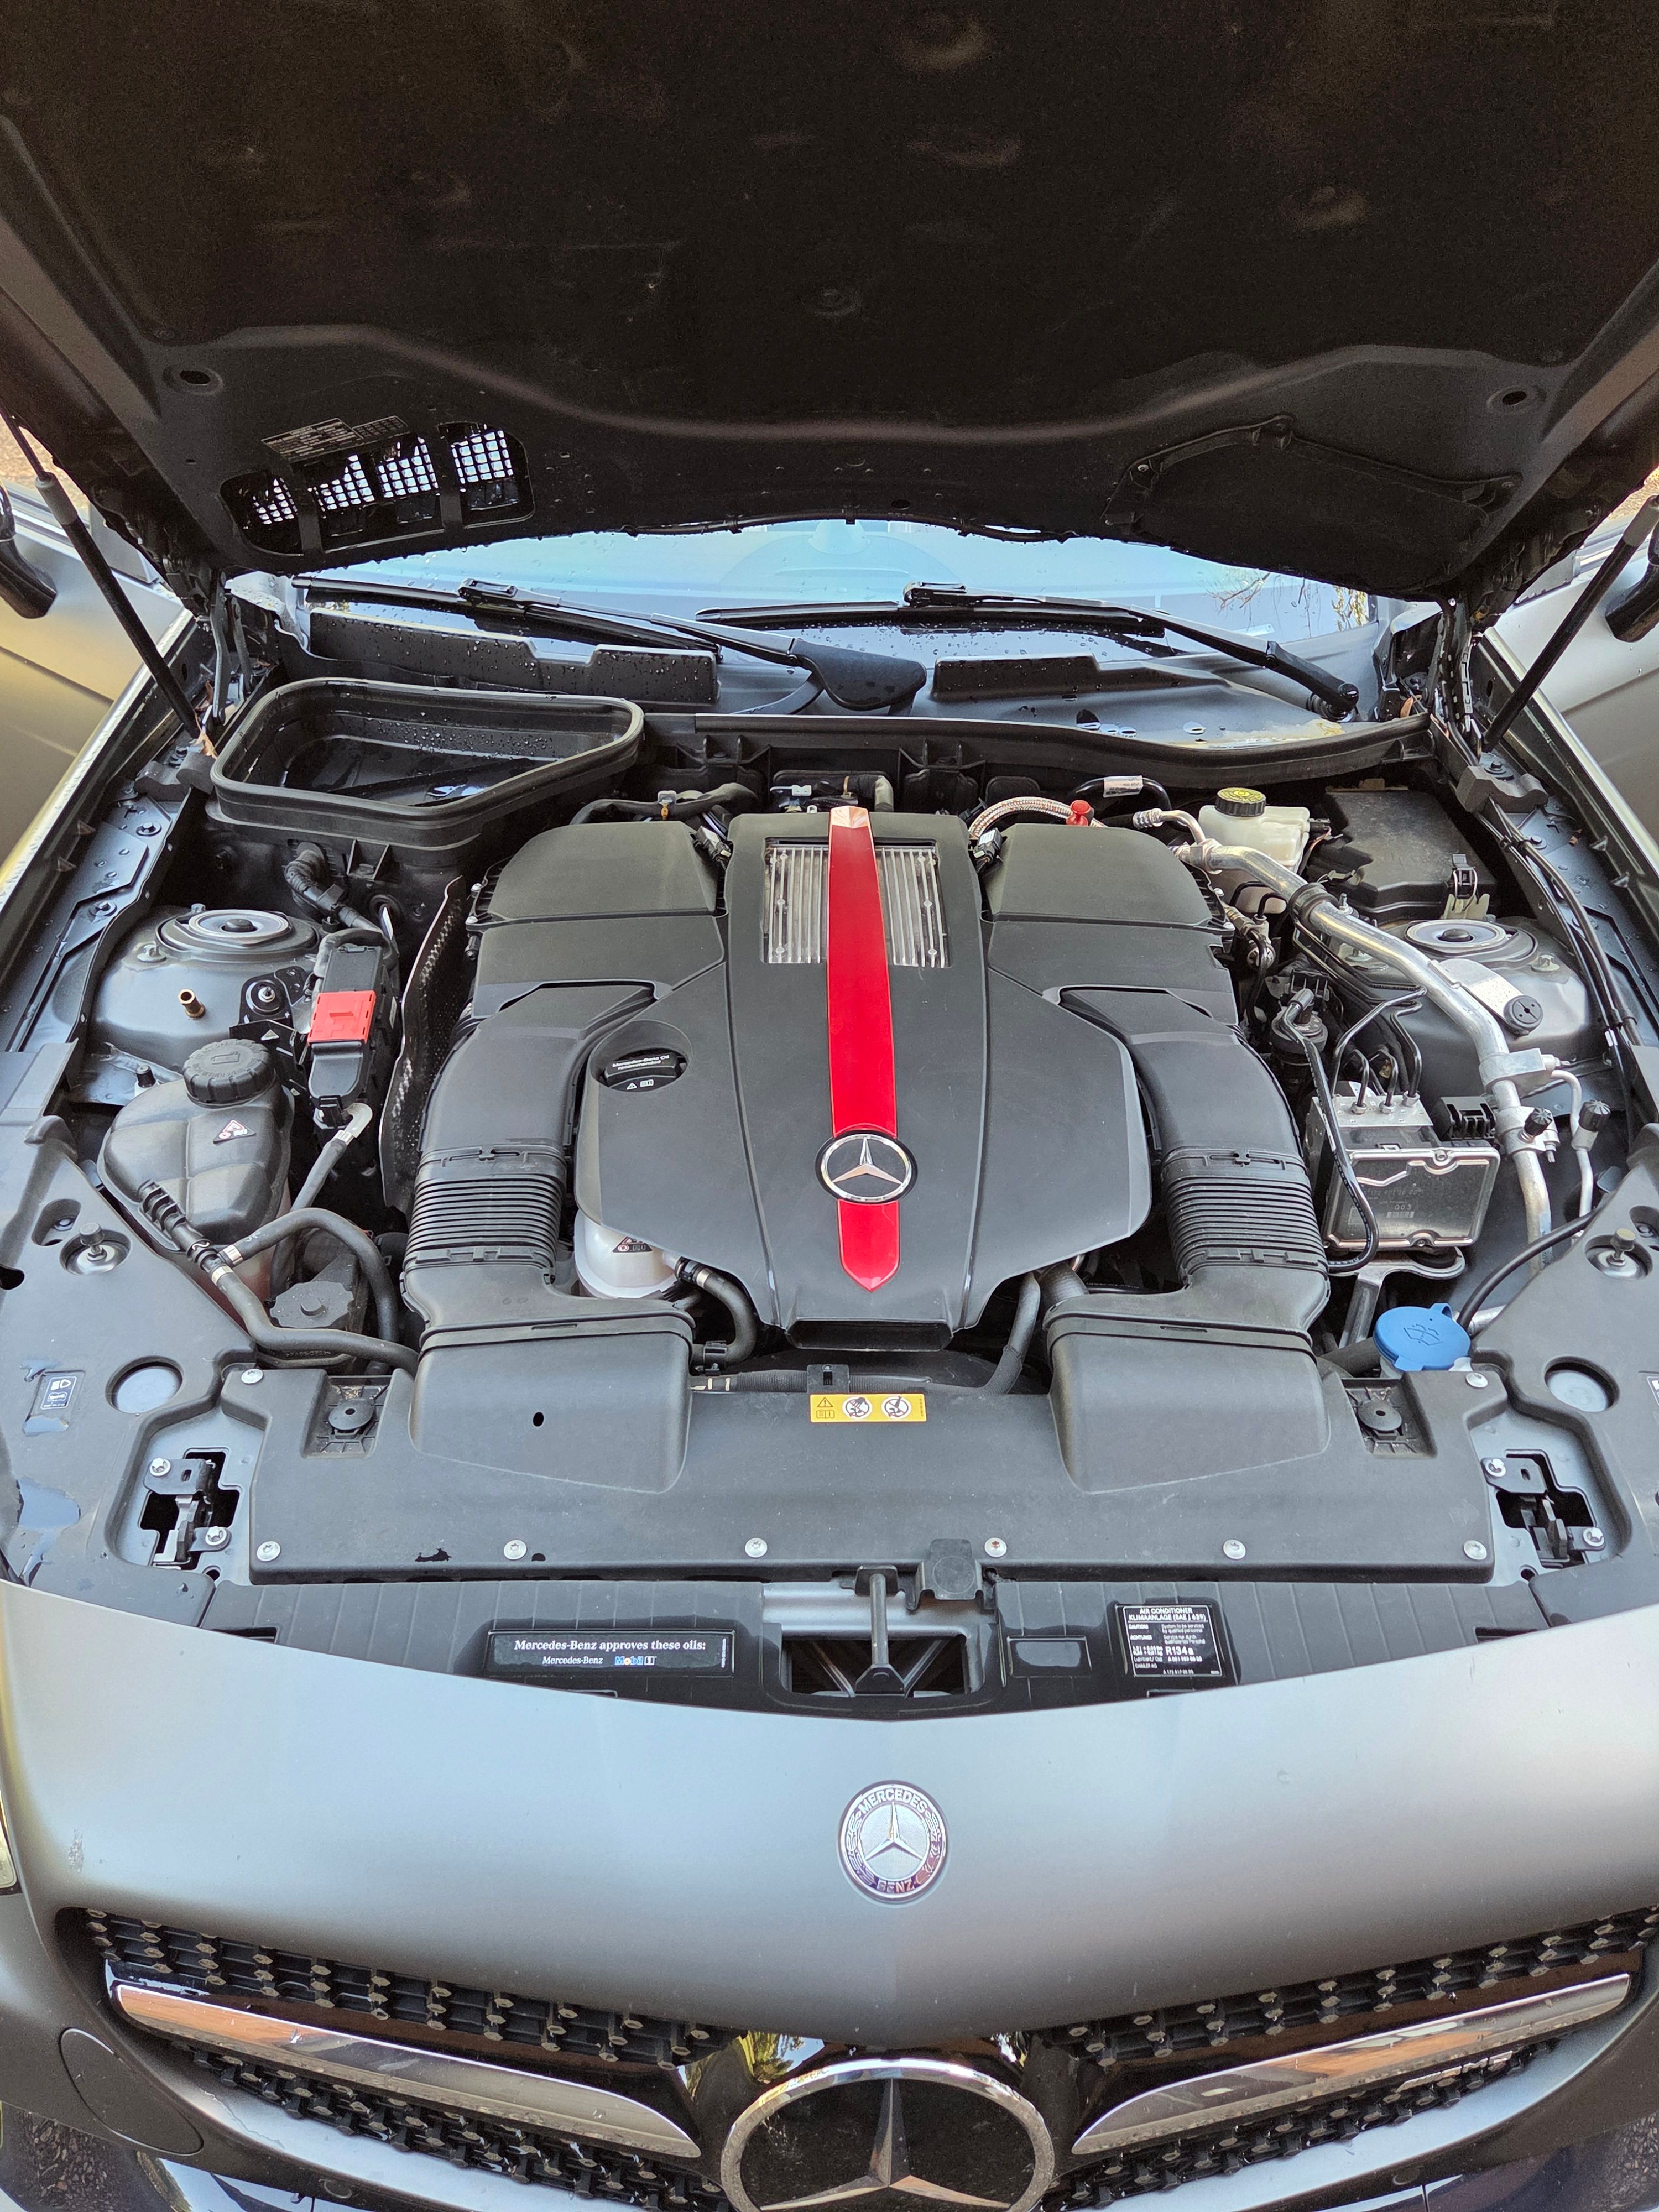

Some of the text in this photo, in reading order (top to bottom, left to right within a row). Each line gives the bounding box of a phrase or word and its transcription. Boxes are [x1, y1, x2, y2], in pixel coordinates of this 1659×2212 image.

[515, 1640, 706, 1652] Mercedes-Benz approves these oils:
[1165, 1646, 1194, 1655] R134a
[542, 1656, 603, 1665] Mercedes-Benz
[614, 1656, 643, 1666] Mobil
[858, 1788, 928, 1814] MERCEDES
[876, 1879, 915, 1893] BENZ
